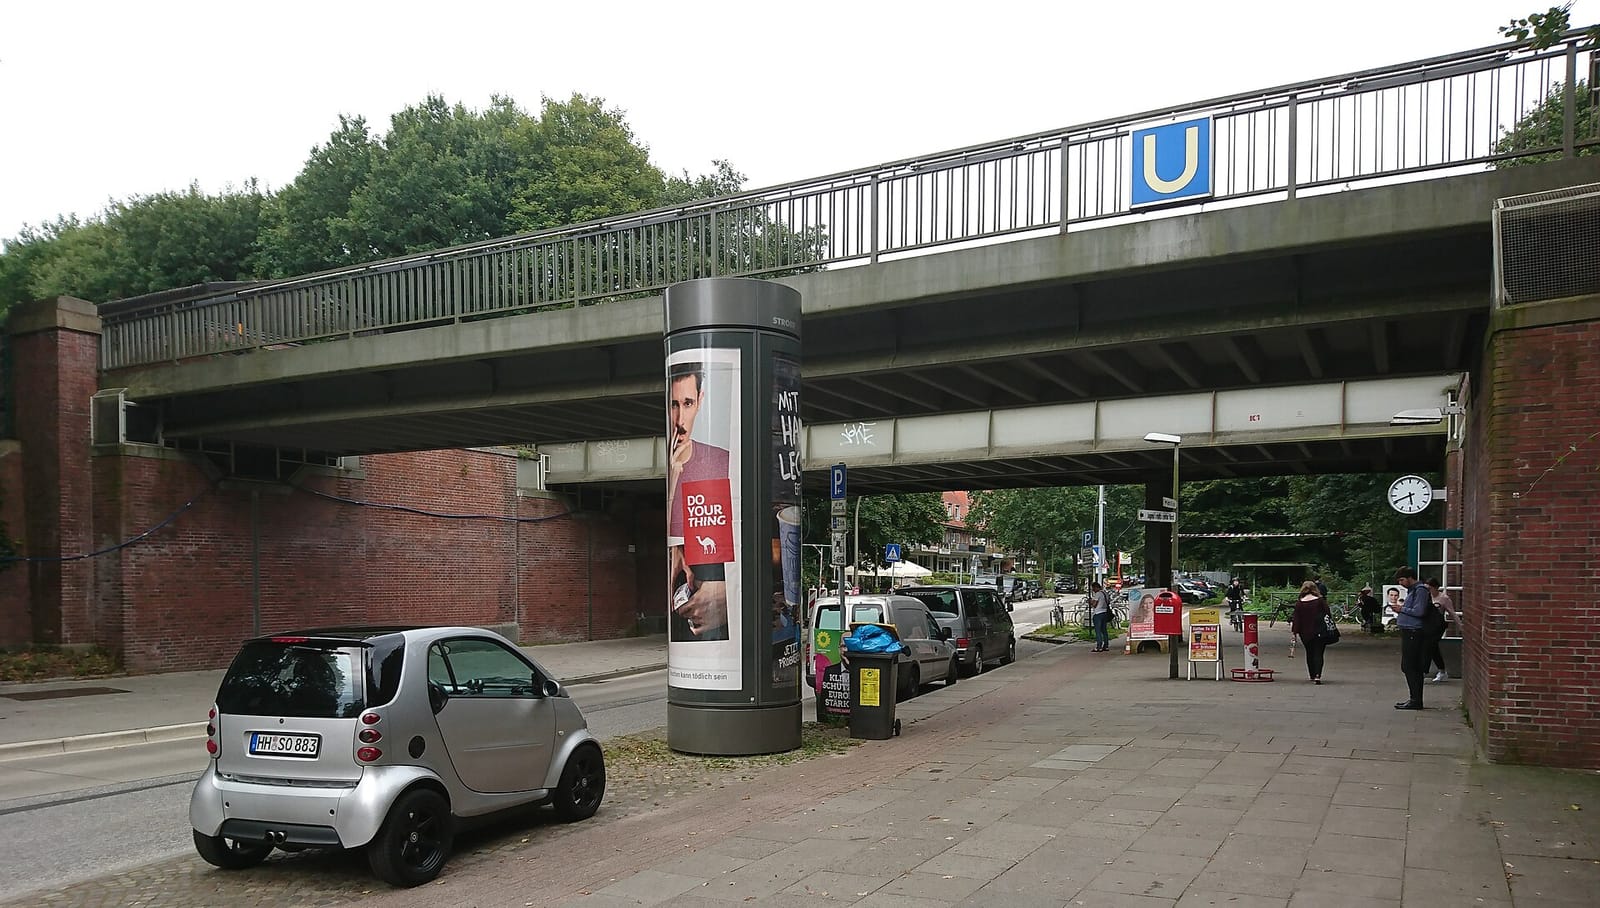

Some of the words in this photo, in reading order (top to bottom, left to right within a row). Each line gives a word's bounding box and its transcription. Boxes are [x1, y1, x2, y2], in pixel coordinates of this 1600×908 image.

[1144, 127, 1198, 193] U
[834, 469, 843, 495] P
[687, 495, 705, 506] DO
[688, 504, 723, 517] YOUR
[688, 515, 727, 528] THING
[257, 736, 272, 750] HH
[278, 737, 293, 751] SO
[295, 738, 317, 752] 883
